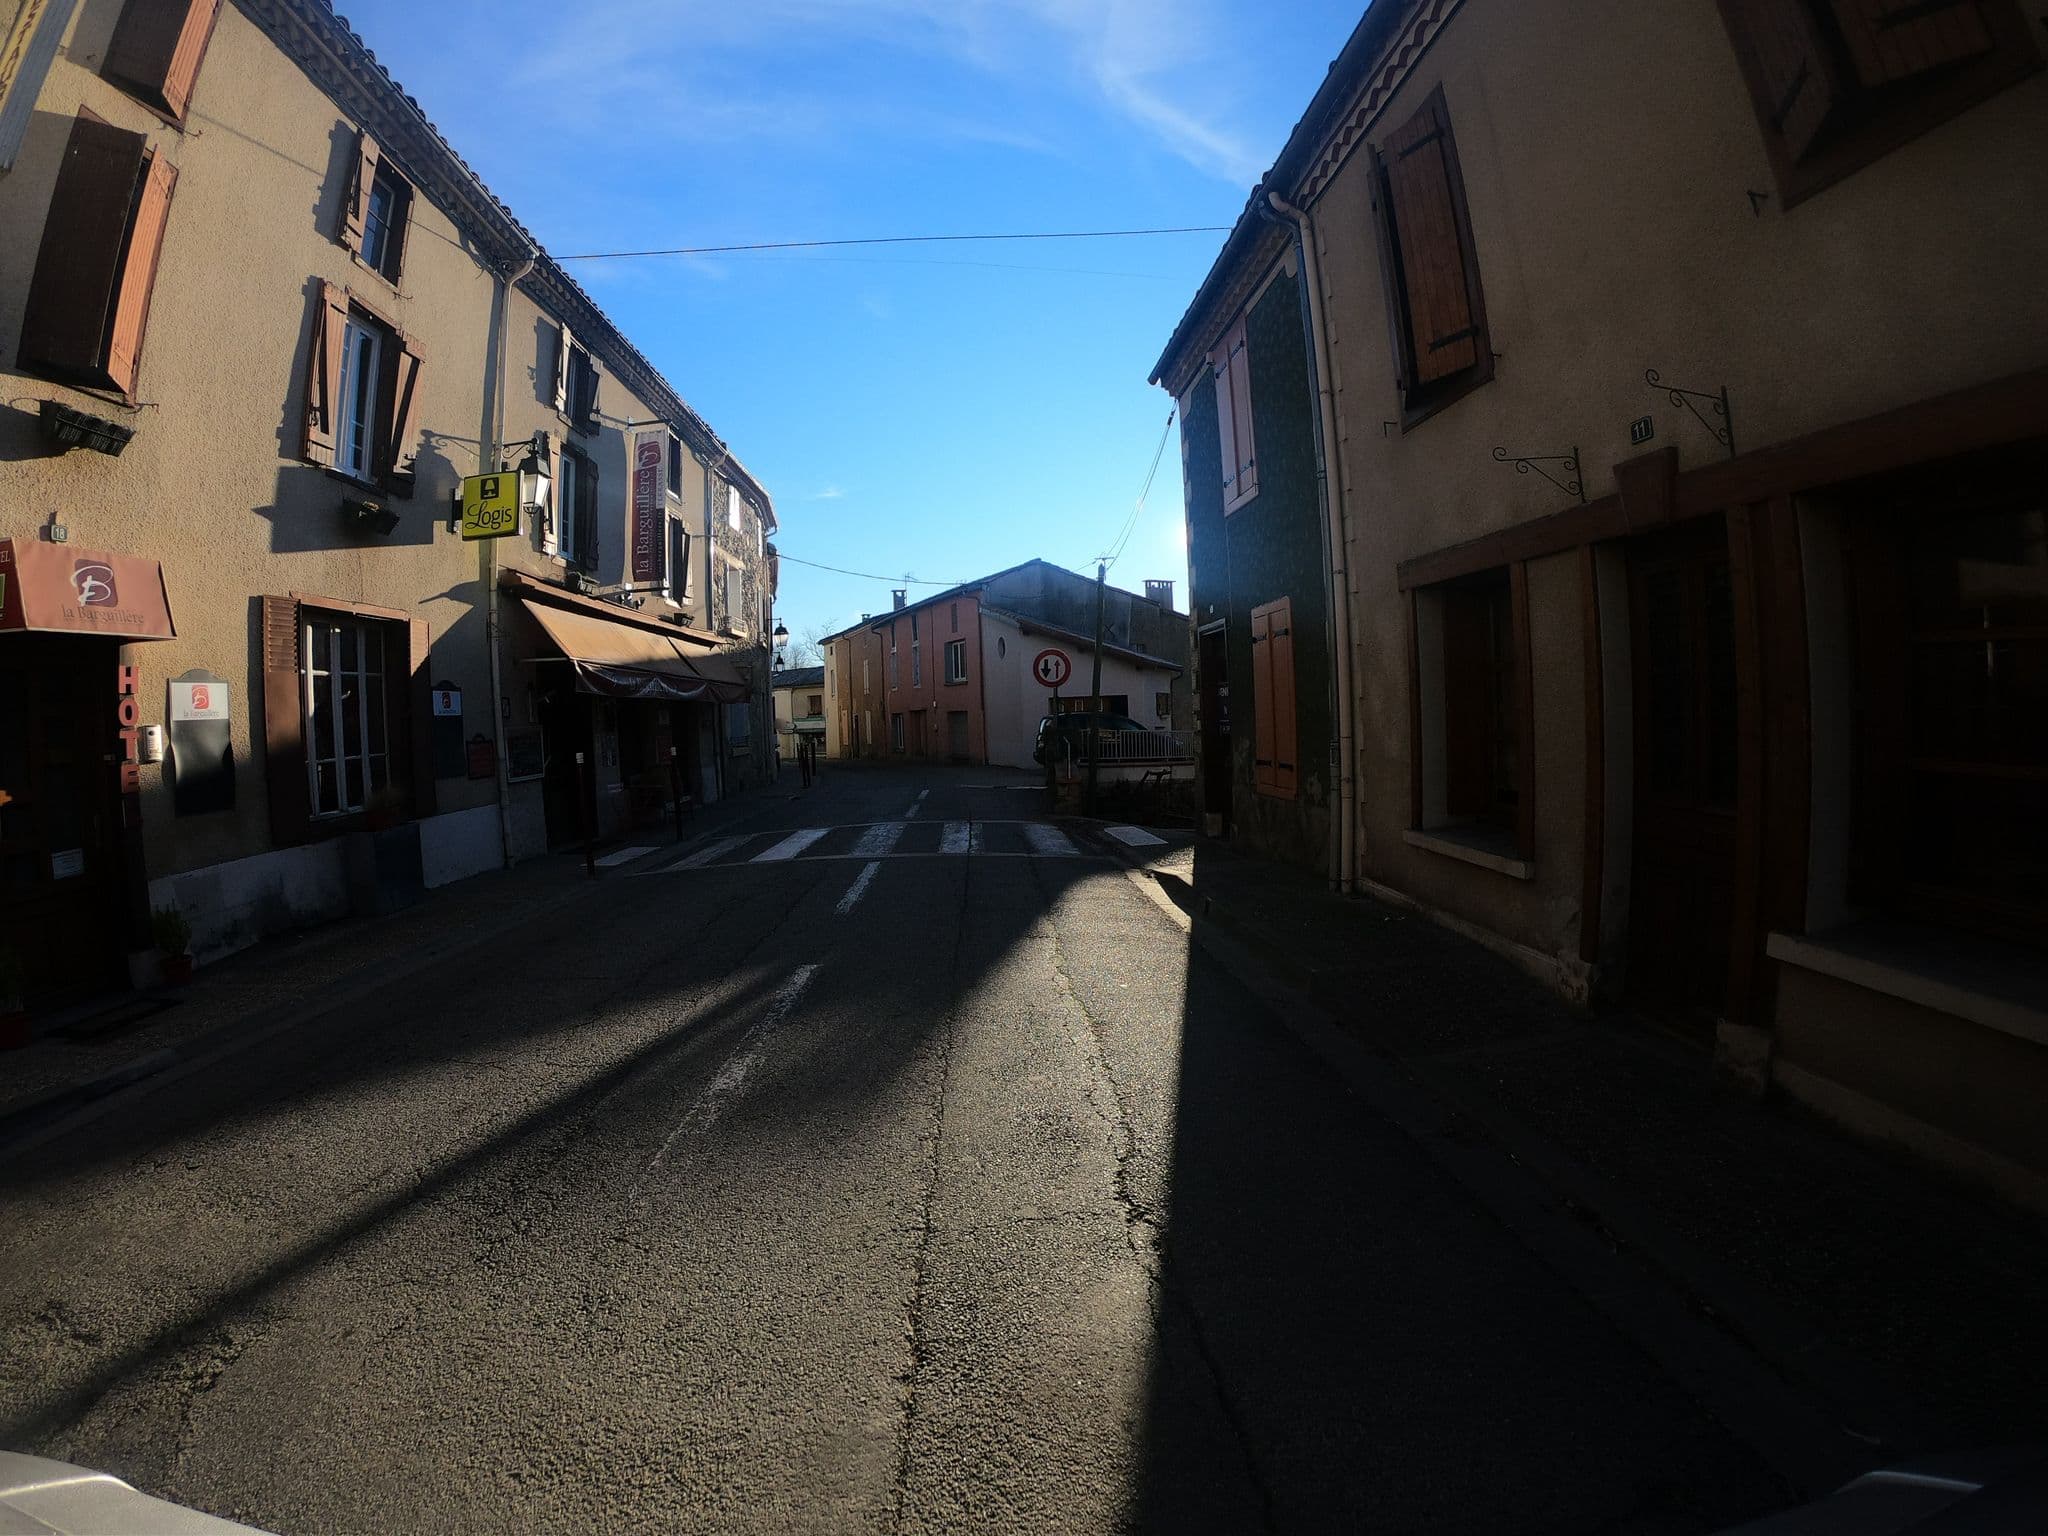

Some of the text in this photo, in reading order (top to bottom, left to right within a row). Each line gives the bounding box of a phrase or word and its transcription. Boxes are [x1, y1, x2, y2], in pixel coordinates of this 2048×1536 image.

[1633, 420, 1646, 439] 11
[465, 501, 512, 530] Logis
[637, 560, 649, 574] la
[62, 604, 74, 617] la
